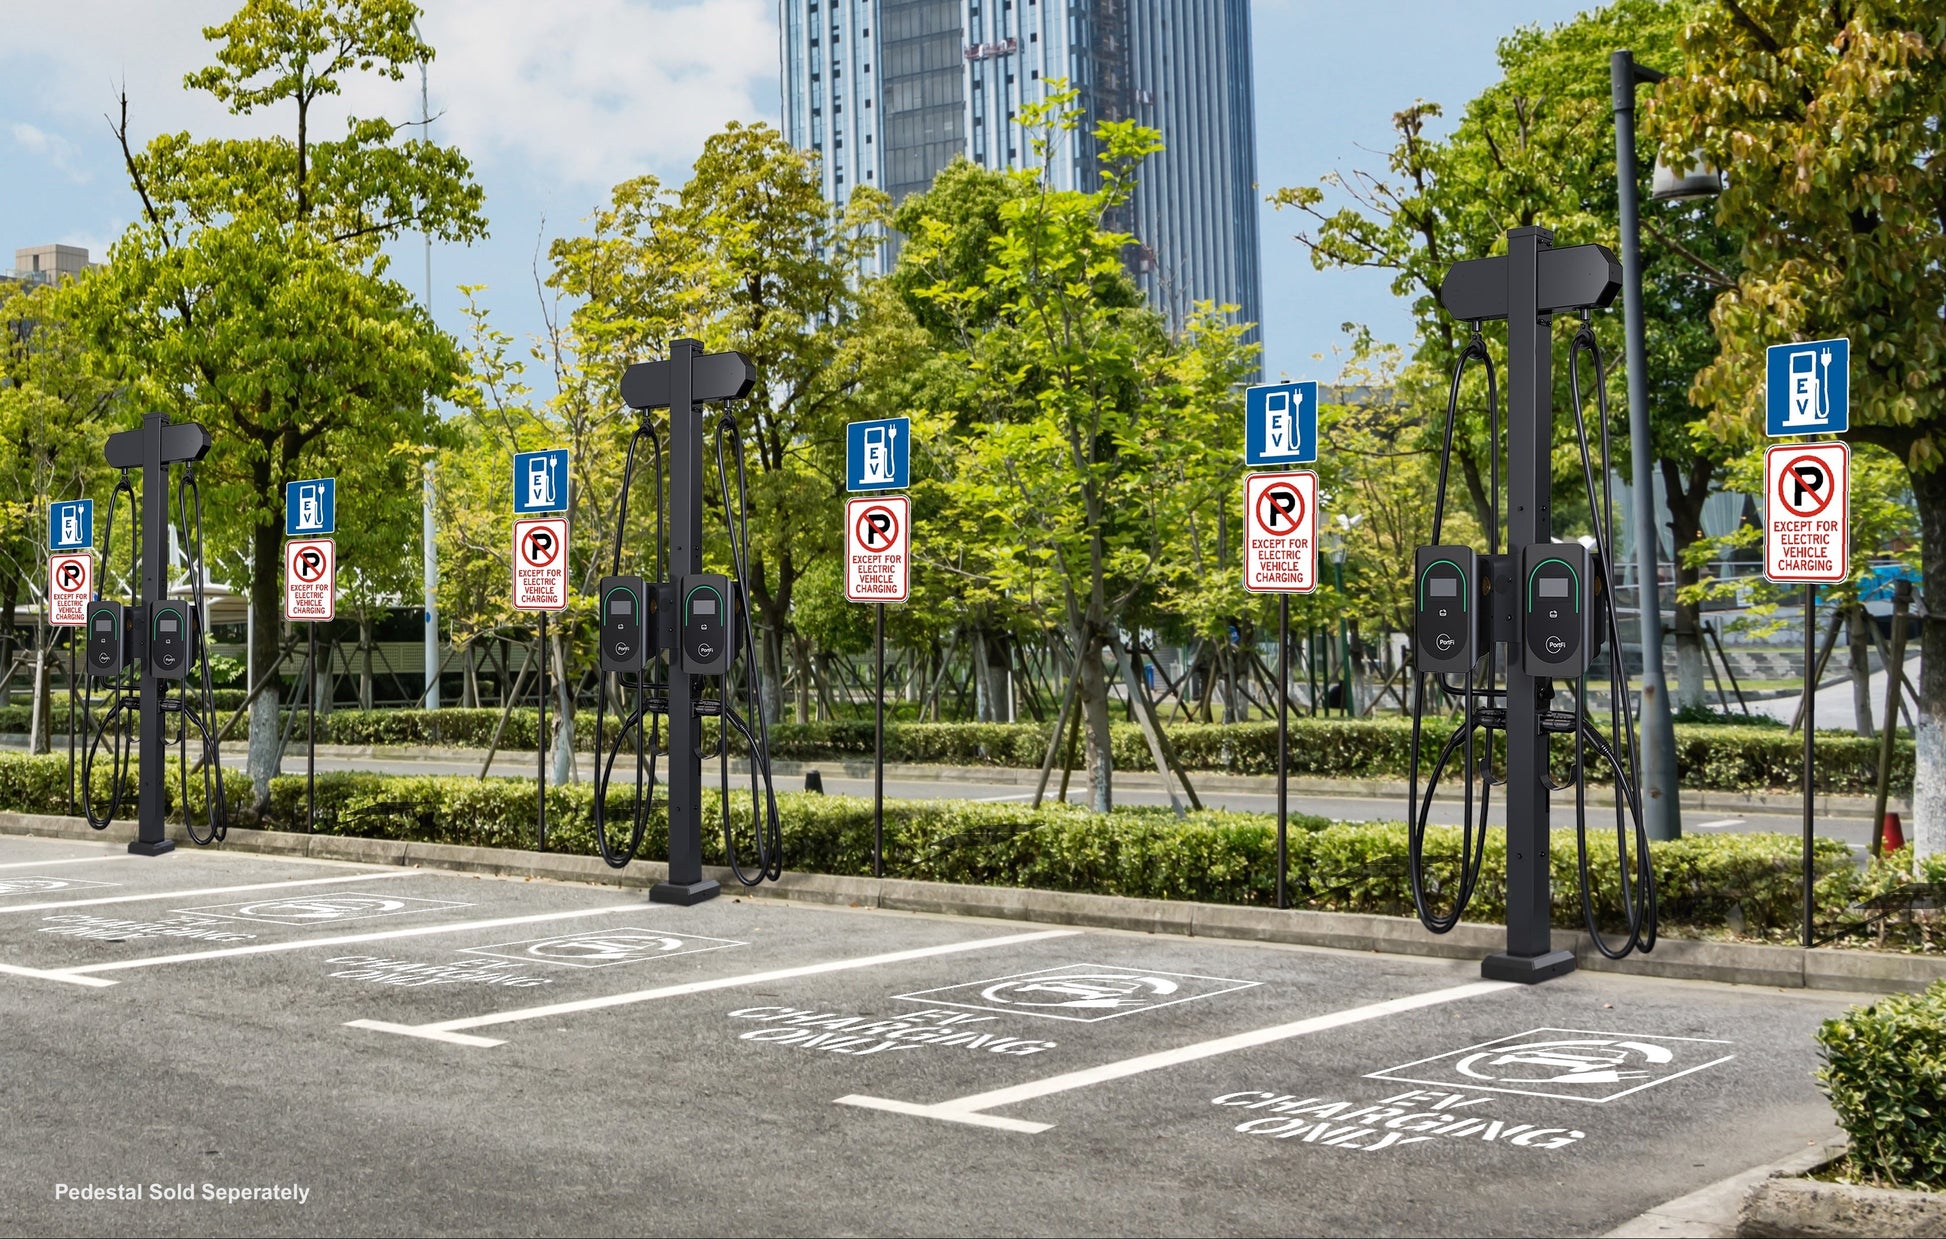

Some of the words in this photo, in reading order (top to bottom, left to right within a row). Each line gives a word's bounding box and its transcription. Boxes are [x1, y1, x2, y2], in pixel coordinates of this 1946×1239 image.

[1774, 521, 1812, 532] EXCEPT
[1816, 521, 1838, 531] FOR
[1252, 539, 1286, 549] EXCEPT
[1289, 539, 1308, 548] FOR
[1781, 534, 1830, 545] ELECTRIC
[1258, 550, 1301, 560] ELECTRIC
[1783, 547, 1827, 558] VEHICLE
[852, 555, 882, 564] EXCEPT
[885, 555, 901, 563] FOR
[858, 565, 895, 573] ELECTRIC
[1260, 561, 1299, 571] VEHICLE
[1778, 560, 1833, 571] CHARGING
[547, 569, 561, 577] FOR
[1255, 572, 1303, 583] CHARGING
[859, 575, 894, 583] VEHICLE
[856, 585, 897, 593] CHARGING
[521, 595, 558, 603] CHARGING
[728, 1006, 1057, 1055] CHARGING
[1378, 1089, 1496, 1110] EV
[1211, 1091, 1585, 1149] CHARGING
[1234, 1117, 1436, 1151] ONLY
